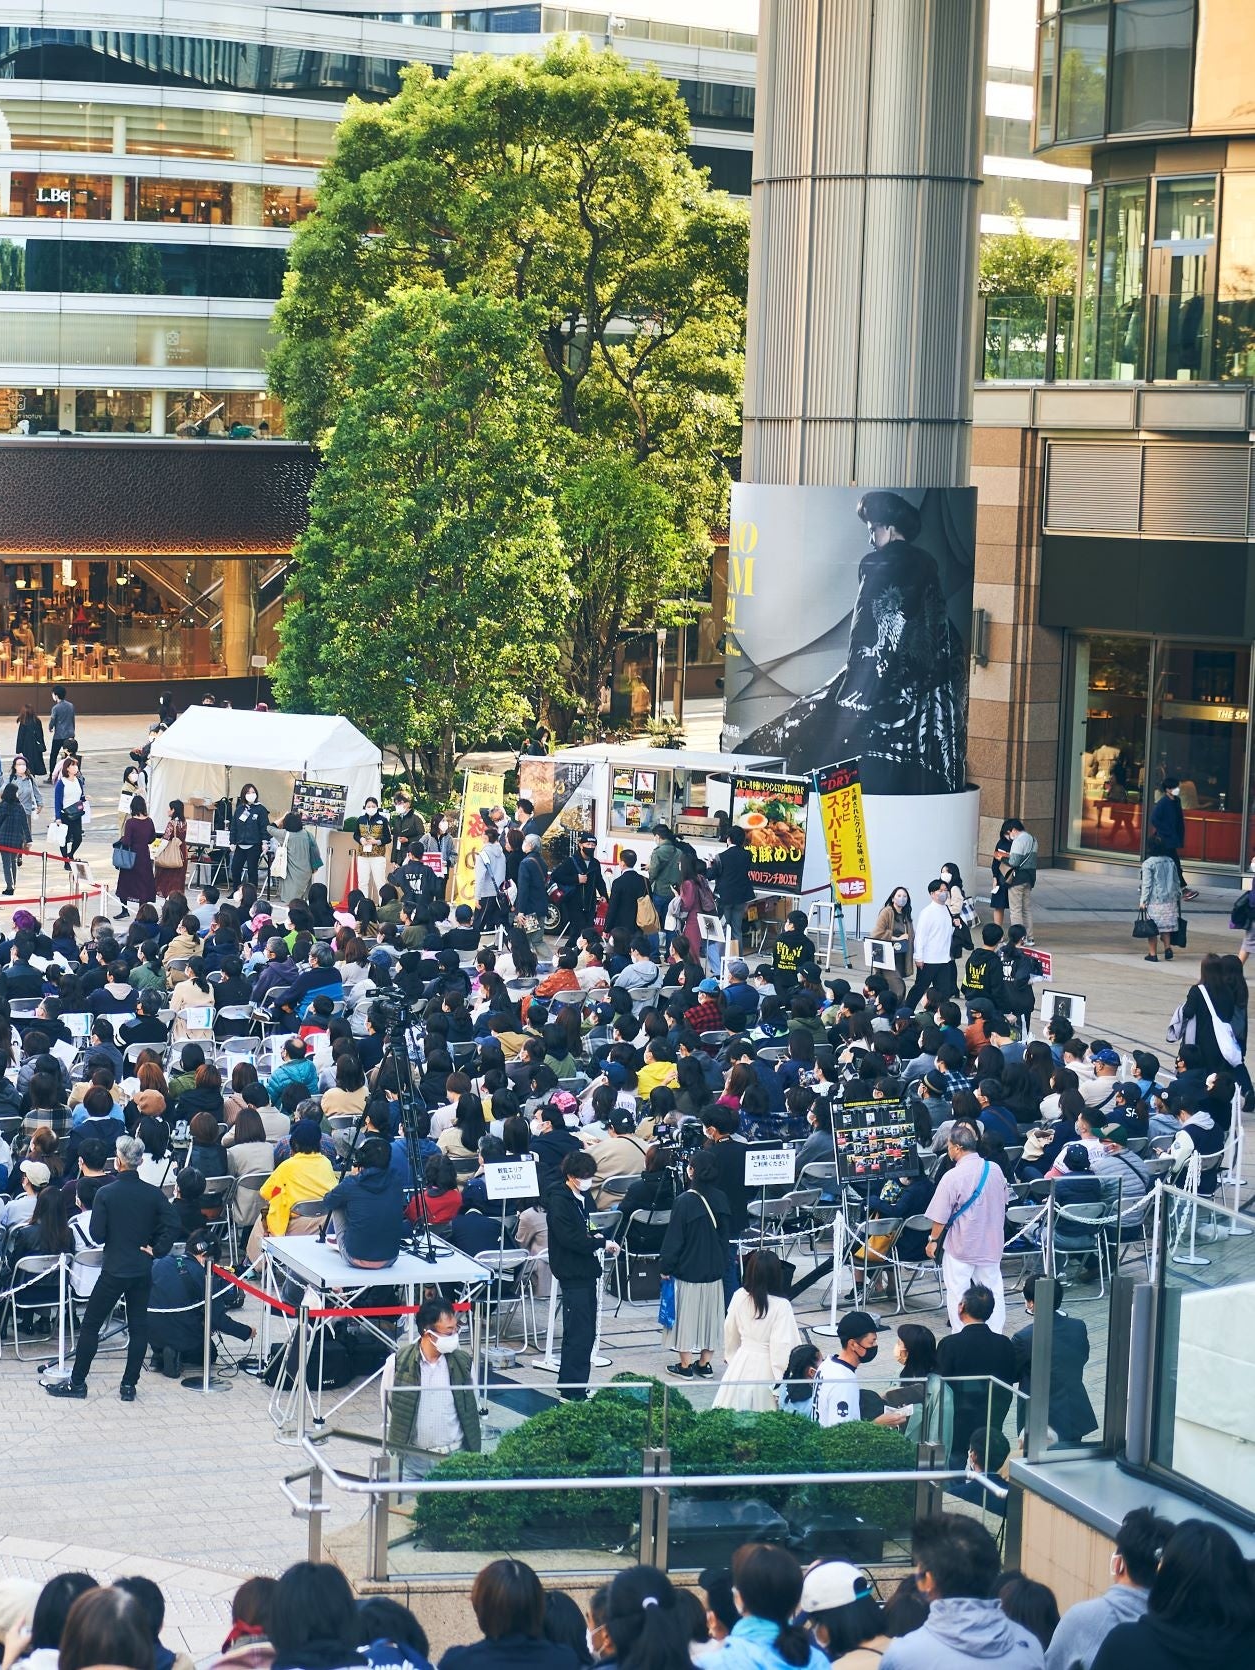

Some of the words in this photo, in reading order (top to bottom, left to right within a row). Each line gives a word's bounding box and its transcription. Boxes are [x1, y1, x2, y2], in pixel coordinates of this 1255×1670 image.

[1217, 710, 1234, 719] THE
[840, 790, 851, 822] アサヒ
[827, 795, 842, 876] スーパードライ
